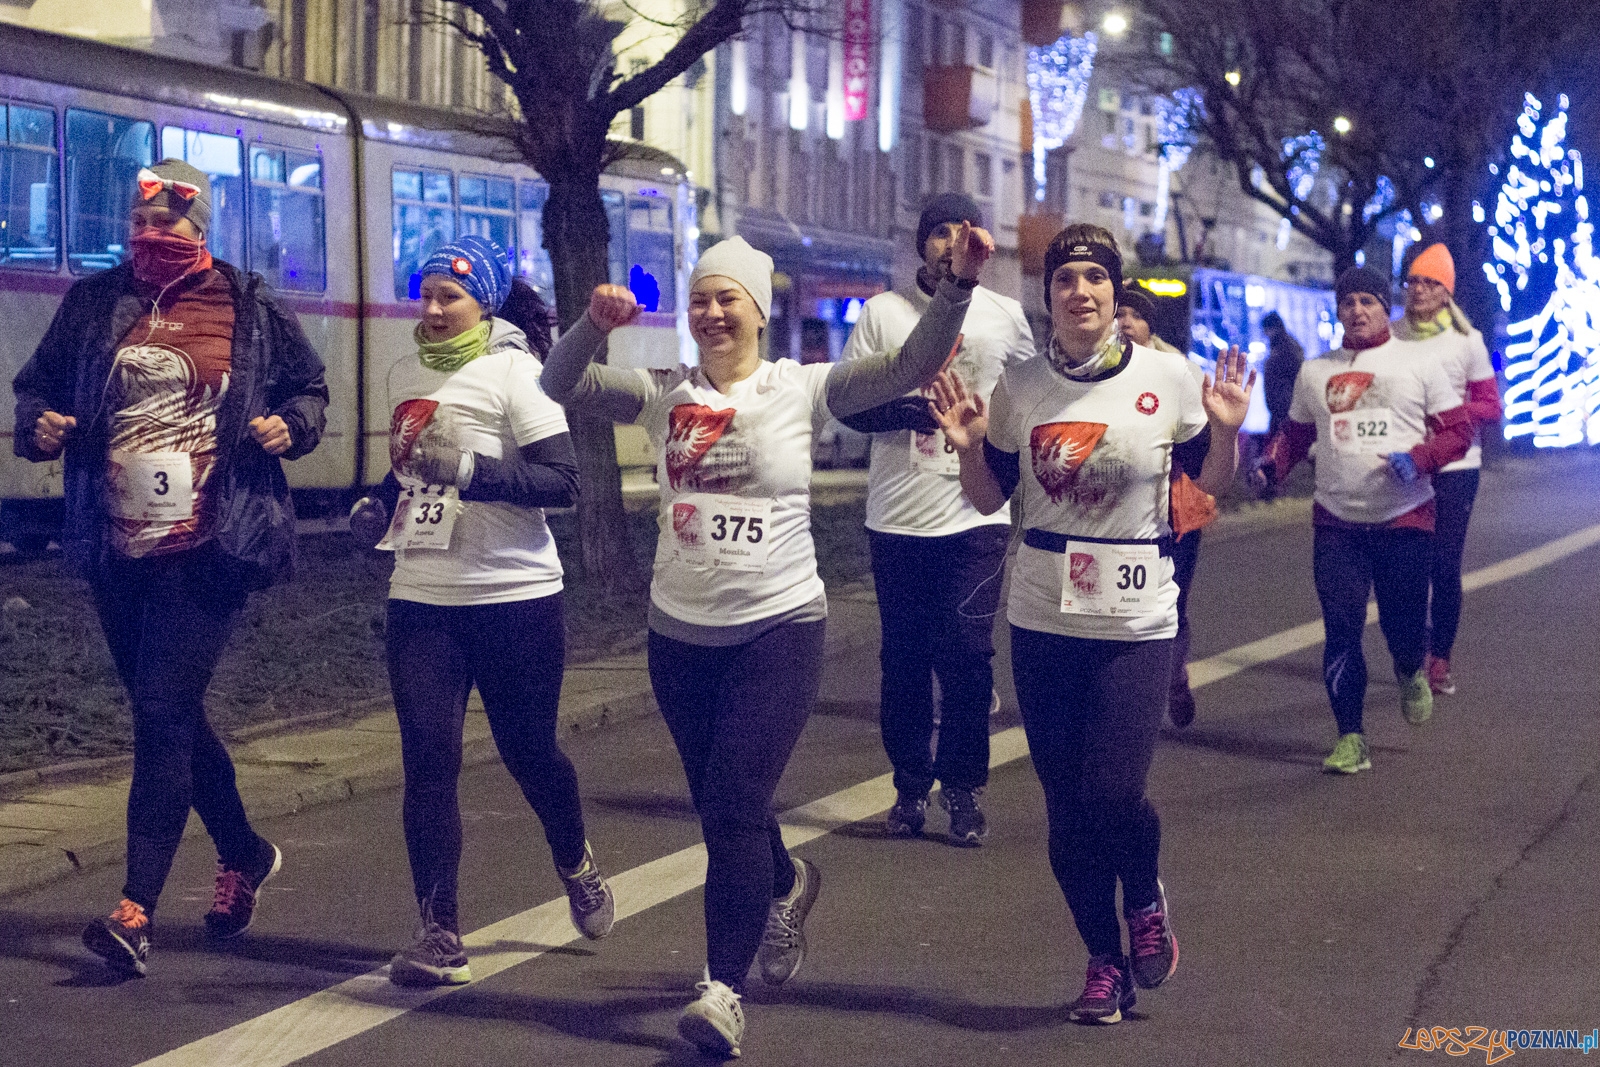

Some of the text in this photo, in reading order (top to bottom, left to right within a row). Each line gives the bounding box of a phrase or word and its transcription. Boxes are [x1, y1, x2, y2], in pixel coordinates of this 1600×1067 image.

[1357, 420, 1388, 437] 522
[153, 471, 169, 496] 3
[415, 502, 445, 524] 33
[710, 514, 763, 544] 375
[719, 547, 751, 557] Monika
[1116, 564, 1147, 590] 30
